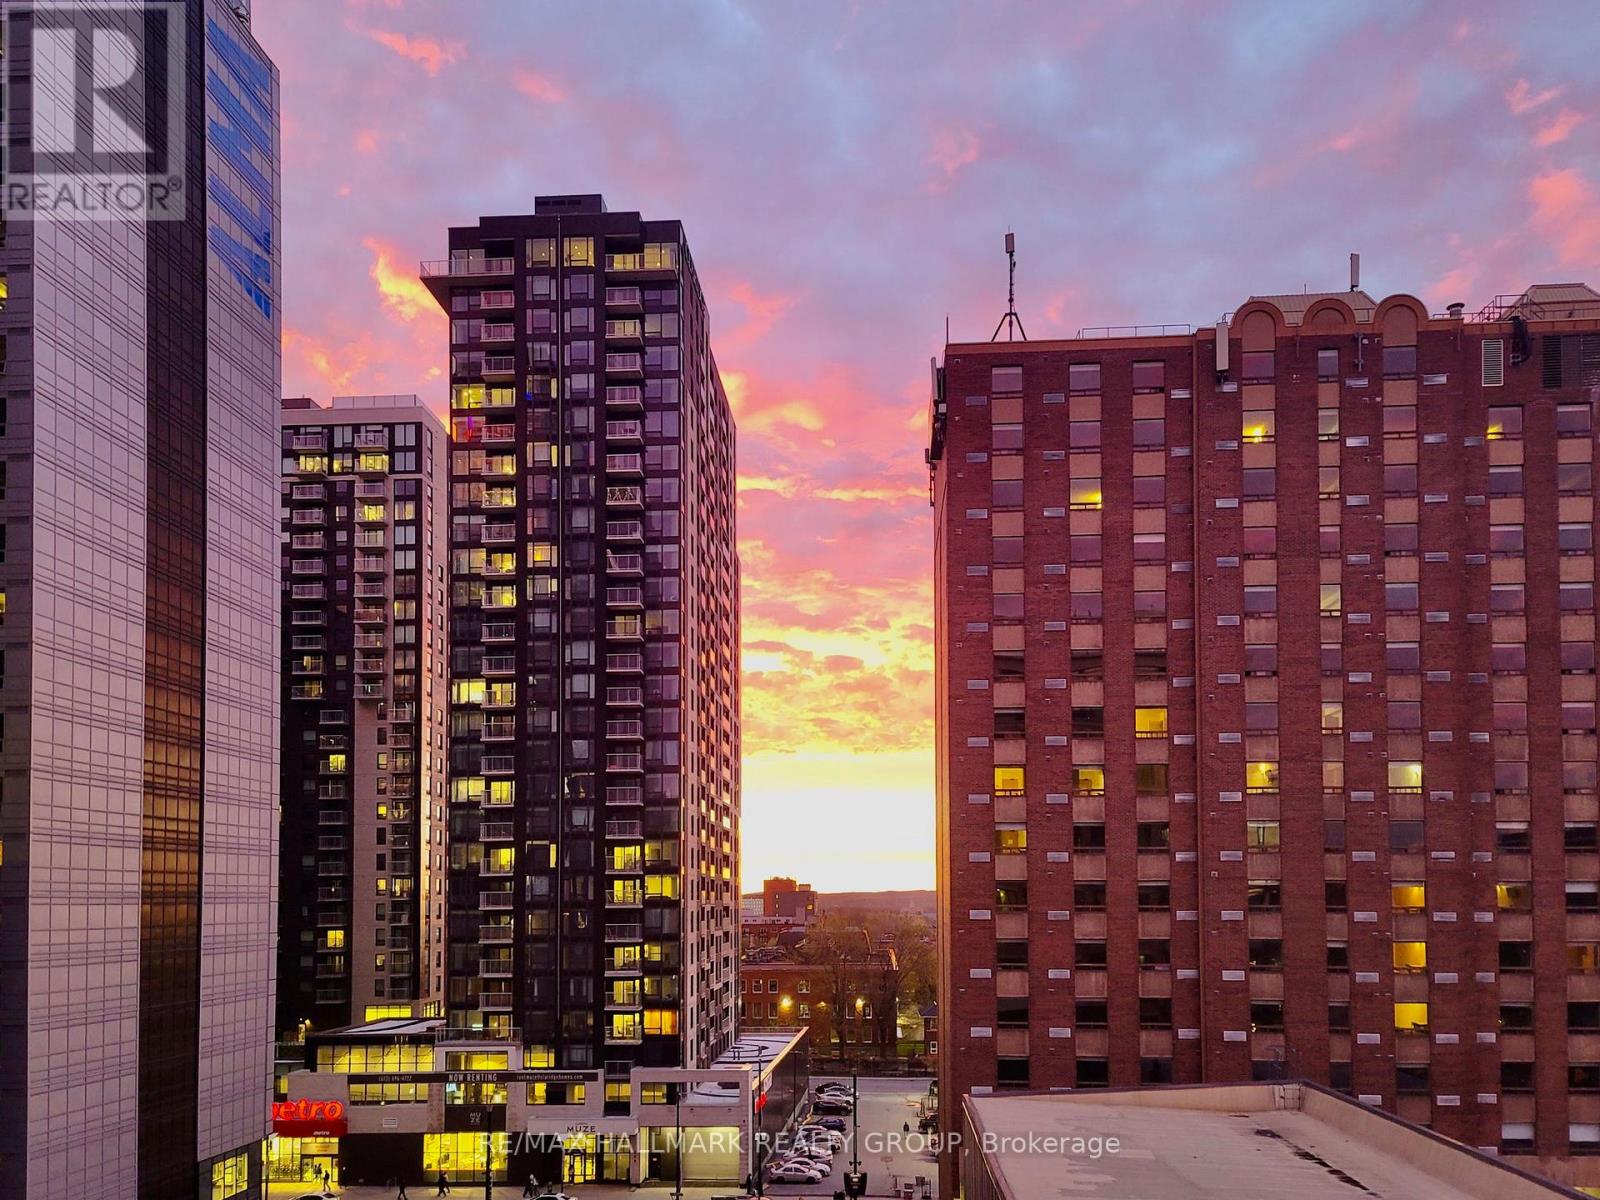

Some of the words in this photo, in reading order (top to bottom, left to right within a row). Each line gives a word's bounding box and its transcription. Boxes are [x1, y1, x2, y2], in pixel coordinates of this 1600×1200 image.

[448, 1073, 464, 1082] NOW
[466, 1073, 498, 1082] RENTING
[272, 1097, 344, 1120] etro
[566, 1125, 596, 1133] MUZE
